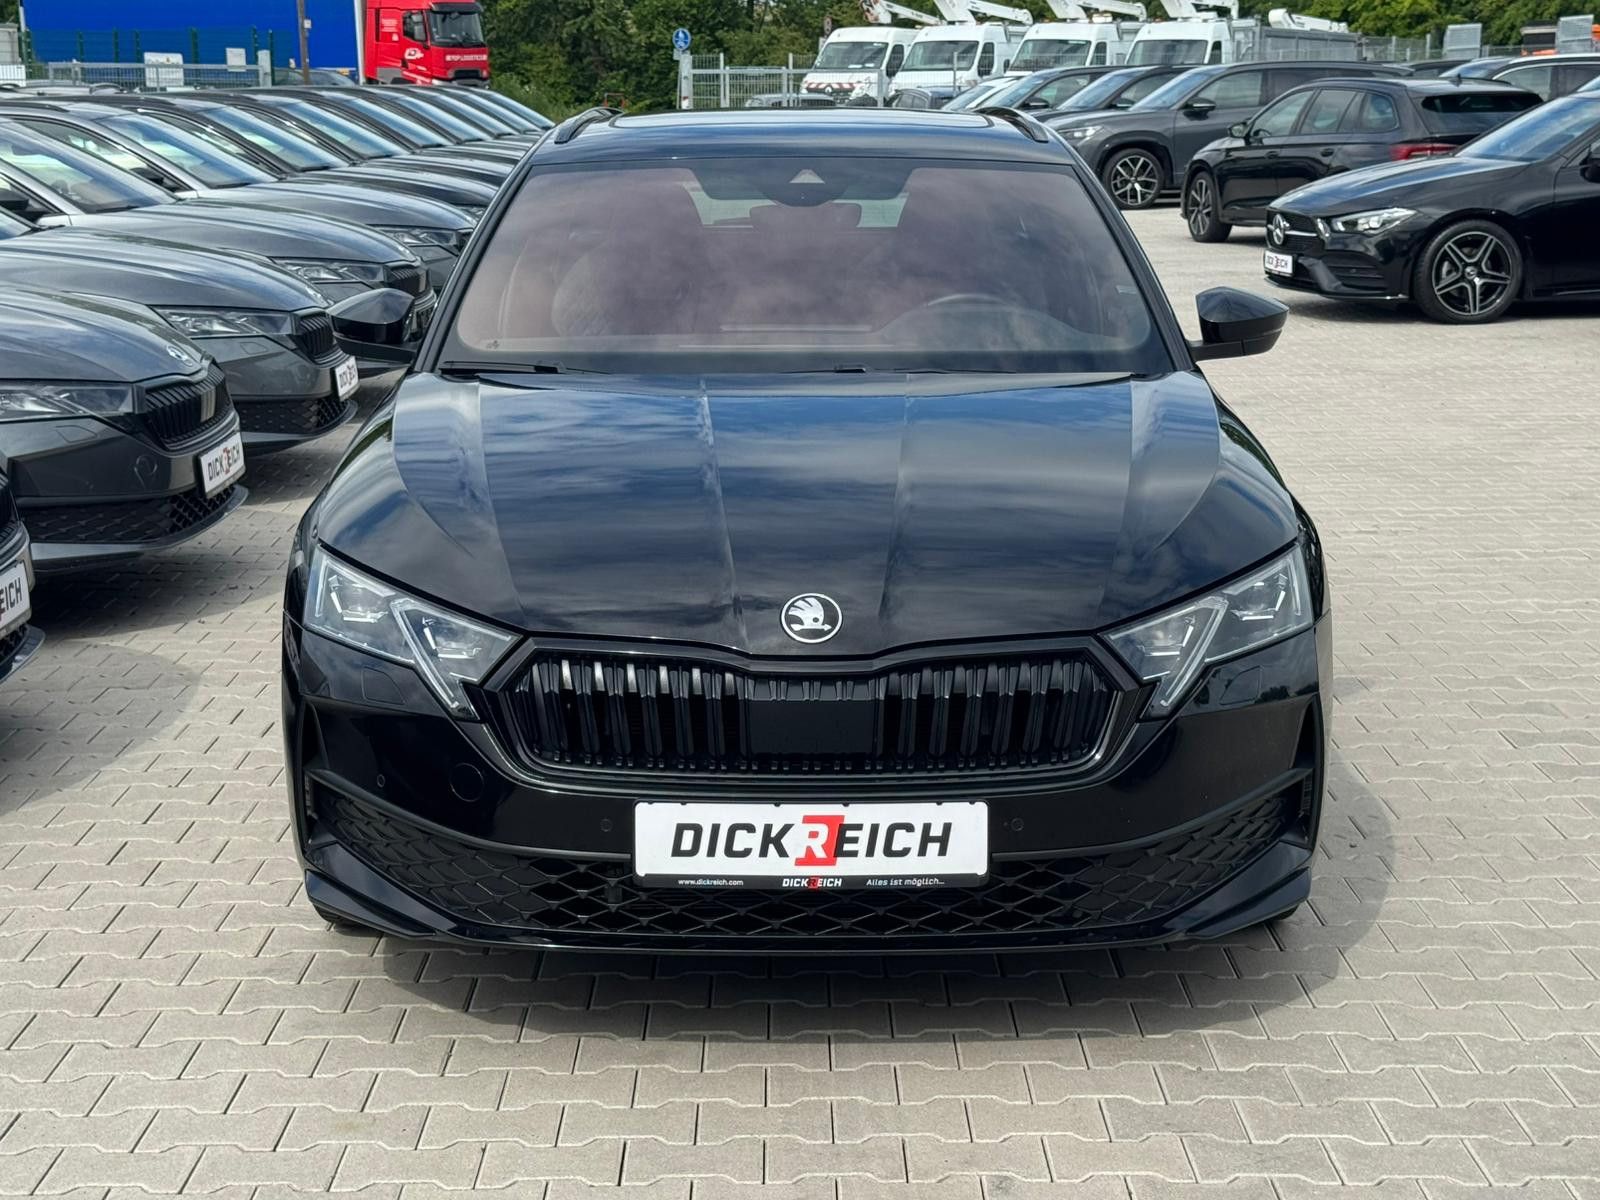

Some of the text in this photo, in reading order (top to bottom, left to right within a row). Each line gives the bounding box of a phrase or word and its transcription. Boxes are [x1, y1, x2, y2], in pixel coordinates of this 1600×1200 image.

[671, 821, 953, 860] DICKREICH
[678, 878, 744, 887] www.dickreich.com
[782, 877, 842, 888] DICKREICH
[866, 878, 888, 887] Alles
[890, 878, 902, 887] ist
